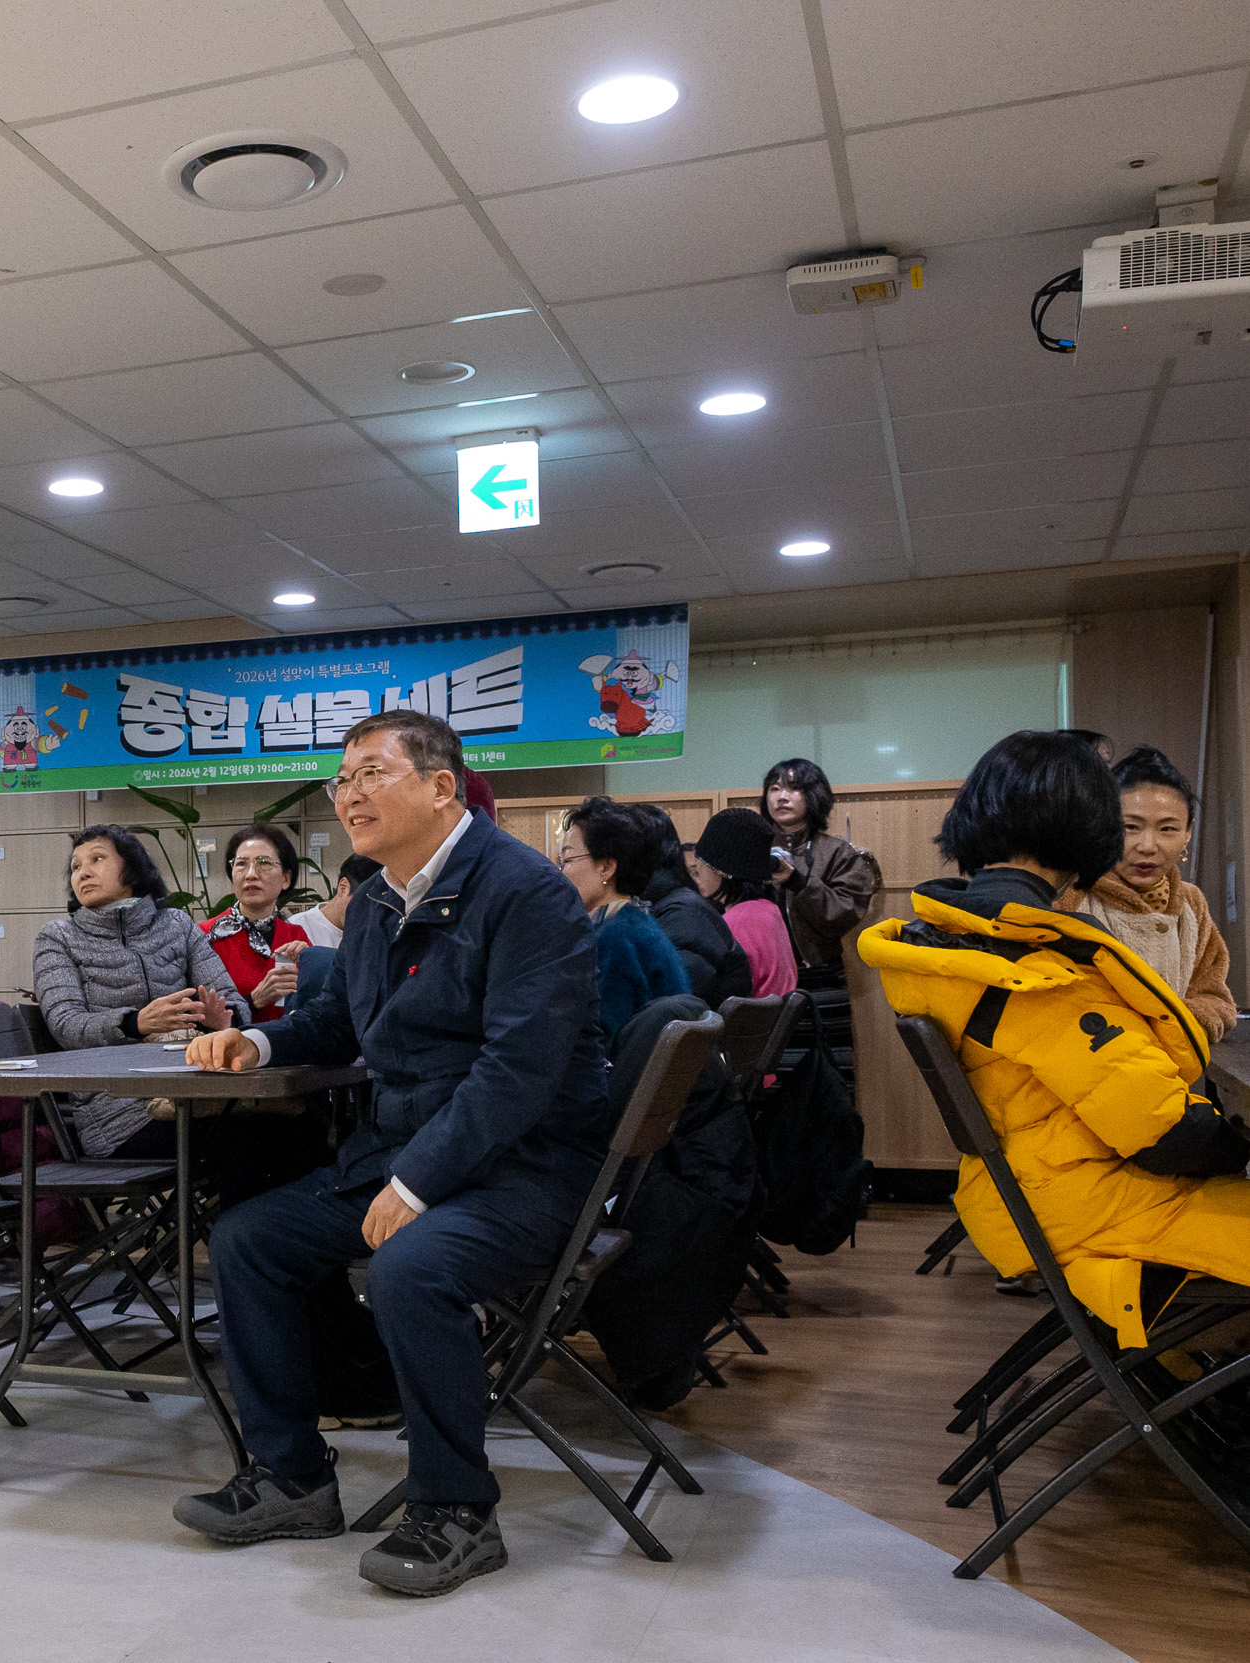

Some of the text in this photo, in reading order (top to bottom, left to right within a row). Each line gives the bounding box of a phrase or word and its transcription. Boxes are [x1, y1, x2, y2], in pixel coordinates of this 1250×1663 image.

[234, 660, 390, 683] 2026년 설맞이 특별프로그램
[119, 672, 250, 753] 종합
[481, 751, 506, 763] 1센터
[143, 769, 160, 780] 일시
[168, 767, 200, 779] 2026년
[202, 766, 217, 777] 2월
[219, 764, 254, 777] 12일(목)
[257, 761, 318, 774] 19:00~21:00
